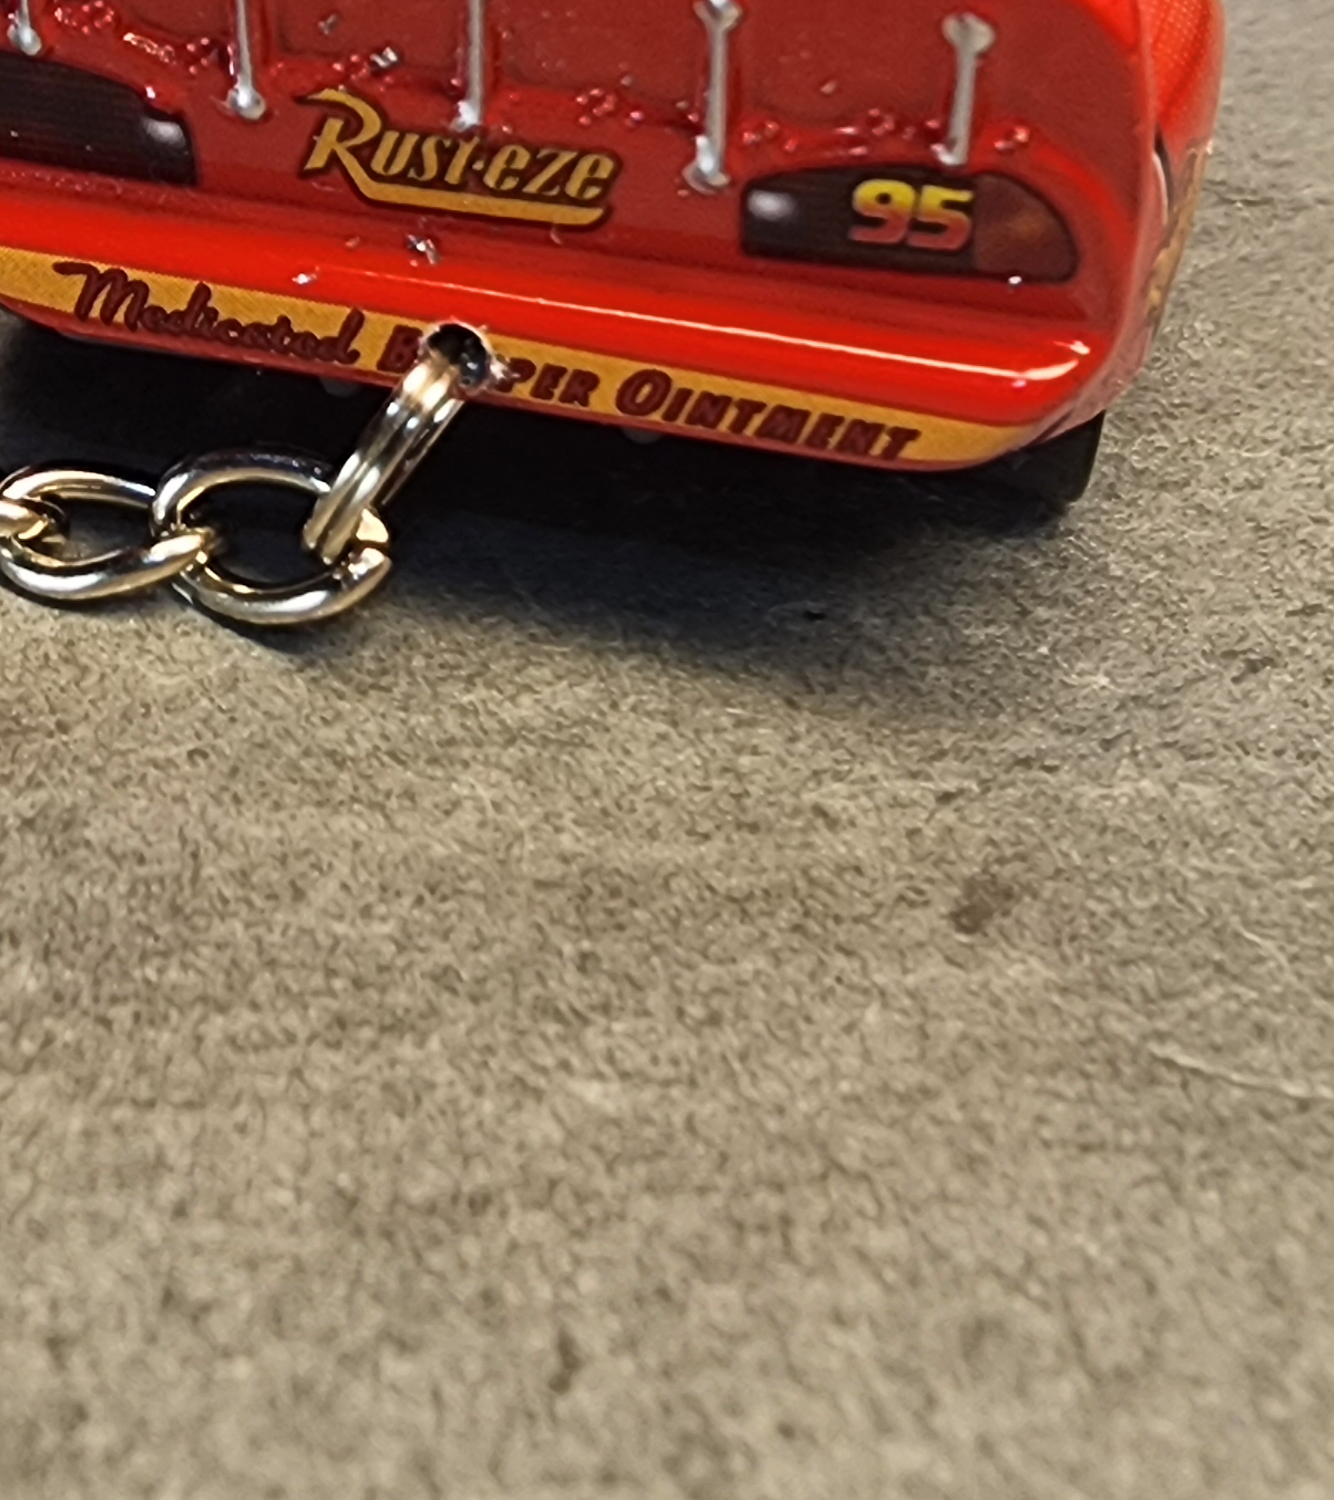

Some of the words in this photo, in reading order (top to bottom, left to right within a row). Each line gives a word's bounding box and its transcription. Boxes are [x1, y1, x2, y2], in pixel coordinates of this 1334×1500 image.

[846, 178, 974, 251] 95
[52, 261, 365, 366] Medicated
[376, 323, 601, 408] BPER
